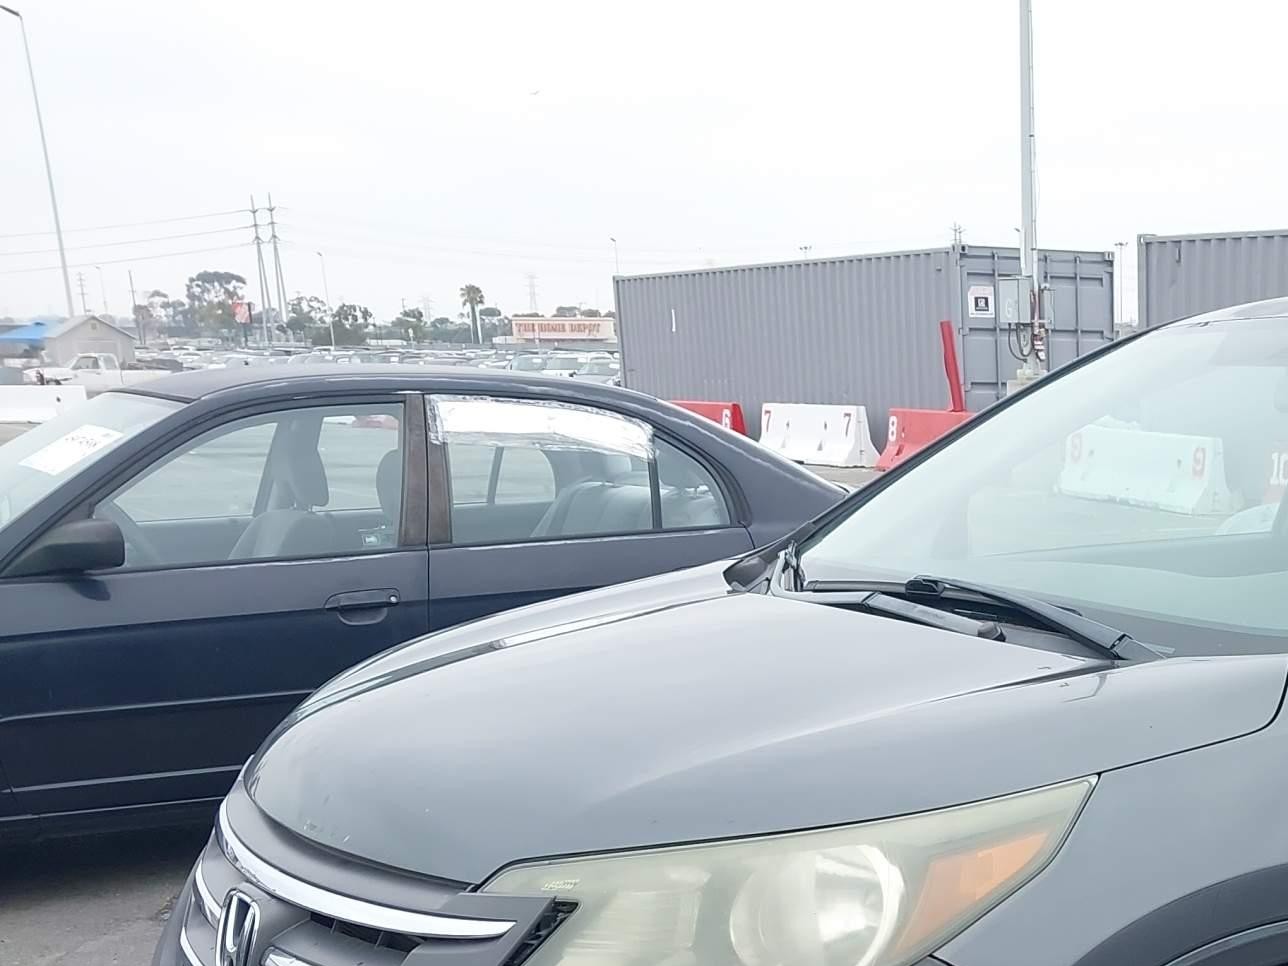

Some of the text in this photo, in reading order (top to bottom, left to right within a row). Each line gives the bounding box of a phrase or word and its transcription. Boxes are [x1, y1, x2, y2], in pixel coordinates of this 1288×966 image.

[722, 408, 731, 430] 6
[763, 410, 772, 432] 7
[843, 413, 852, 437] 7
[888, 416, 898, 442] 8
[1191, 447, 1206, 481] 9
